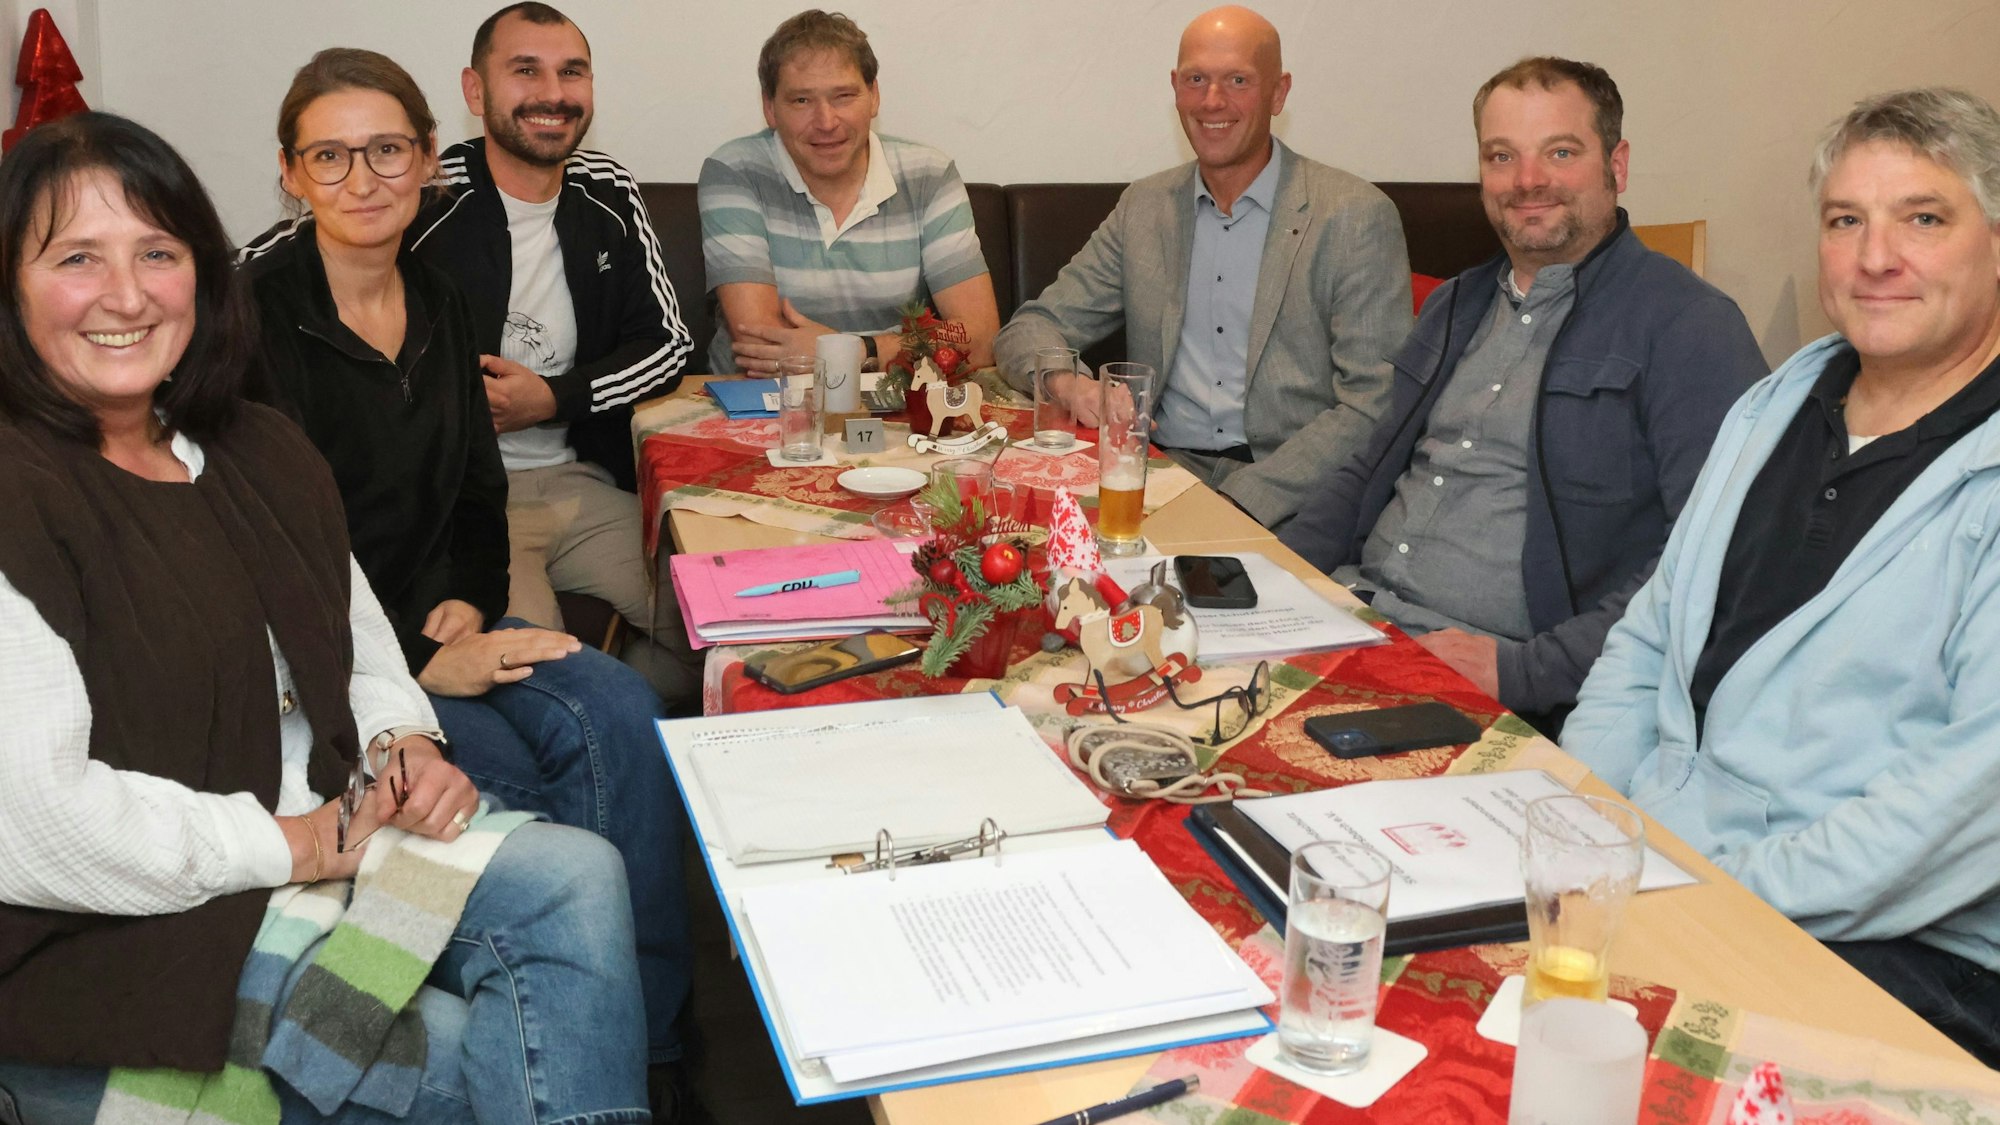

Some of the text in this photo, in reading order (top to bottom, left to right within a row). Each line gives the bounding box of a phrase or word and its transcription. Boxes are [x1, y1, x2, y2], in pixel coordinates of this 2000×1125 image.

[857, 431, 873, 442] 17
[781, 579, 813, 593] CDU
[1098, 702, 1126, 714] Mrry
